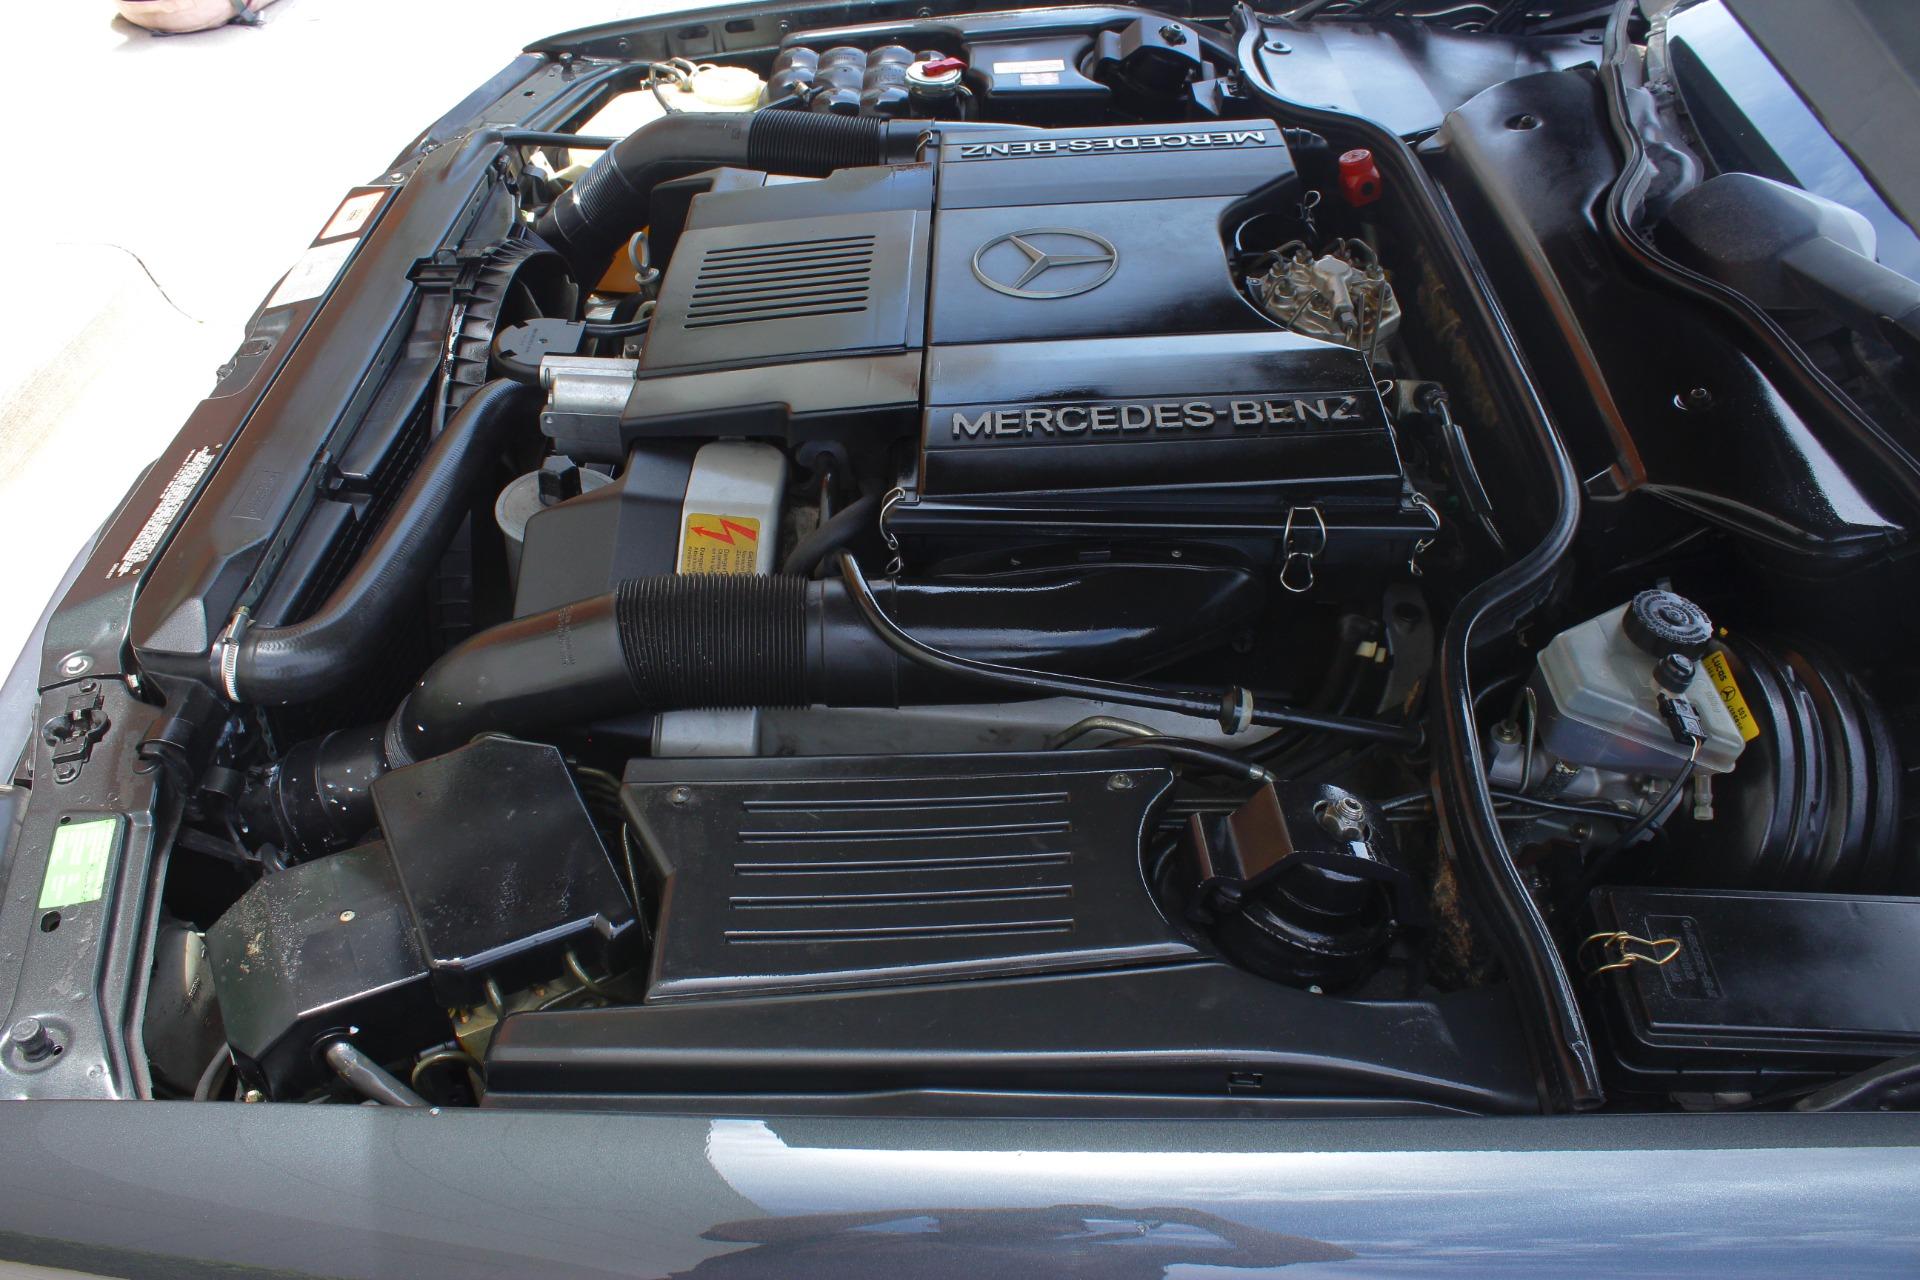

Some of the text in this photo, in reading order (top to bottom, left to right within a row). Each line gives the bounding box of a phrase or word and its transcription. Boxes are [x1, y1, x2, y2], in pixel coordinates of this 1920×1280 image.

[961, 131, 1267, 158] MERCEDES-BENZ
[952, 394, 1361, 439] MERCEDES-BENZ
[1712, 654, 1727, 682] Lucas
